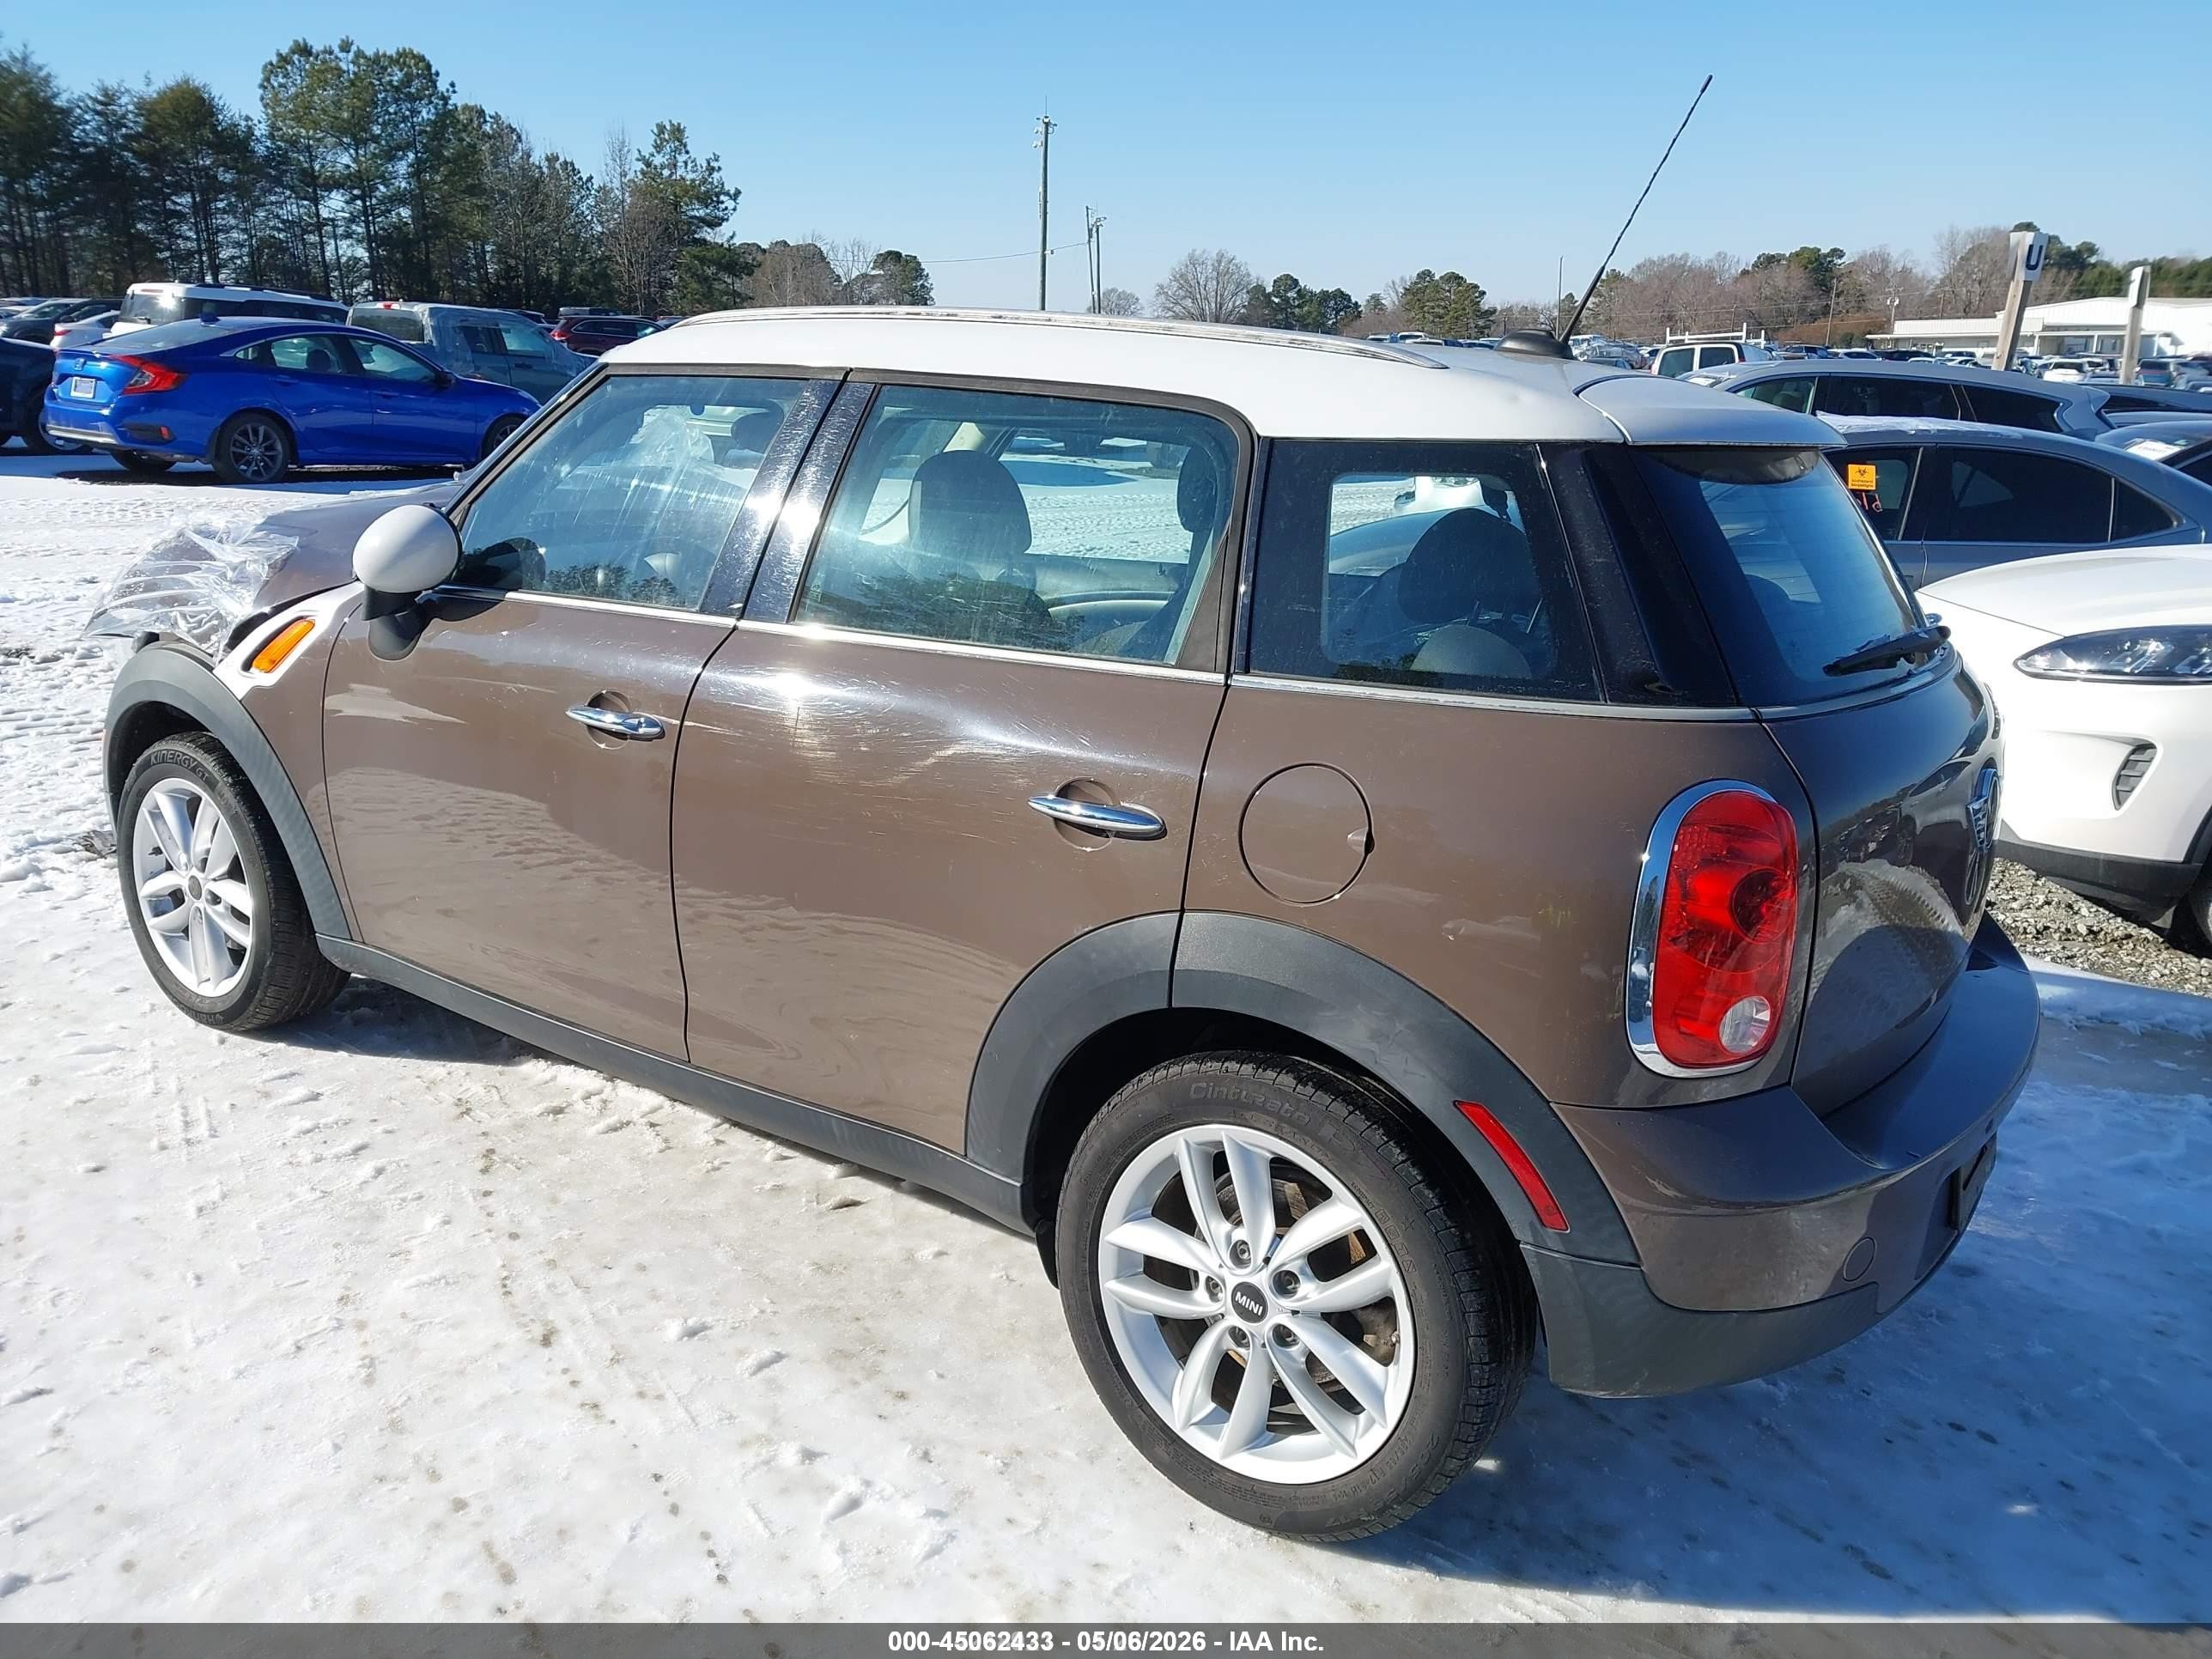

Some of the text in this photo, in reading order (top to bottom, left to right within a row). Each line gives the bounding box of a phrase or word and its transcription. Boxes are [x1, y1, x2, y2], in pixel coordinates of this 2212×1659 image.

[2026, 244, 2044, 270] U
[150, 750, 210, 782] KINERGY GT
[1188, 1082, 1311, 1127] Cinturato
[1235, 1291, 1263, 1316] MINI
